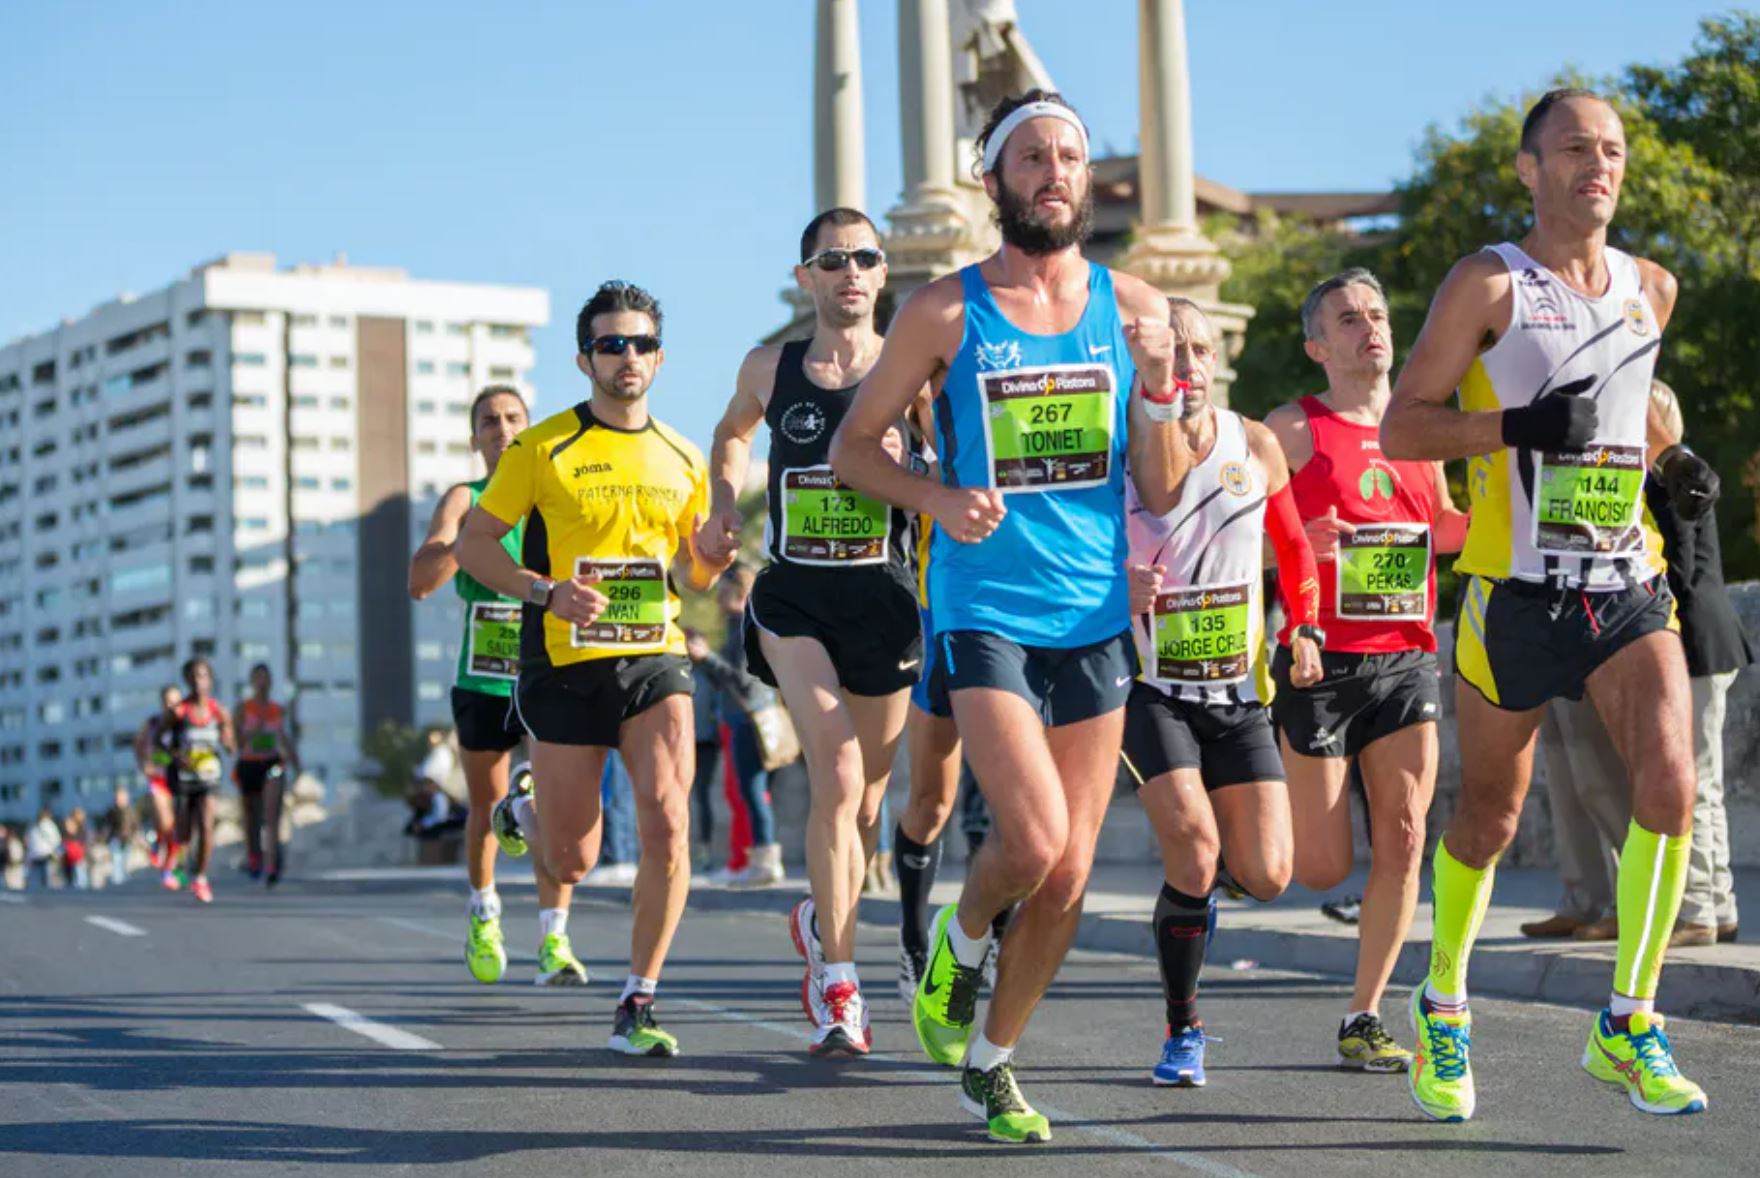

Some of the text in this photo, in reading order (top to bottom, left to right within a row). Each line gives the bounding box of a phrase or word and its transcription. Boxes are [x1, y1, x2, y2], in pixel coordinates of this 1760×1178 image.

[1030, 403, 1073, 424] 267
[1020, 427, 1084, 453] TONIET
[1582, 475, 1618, 494] 144
[819, 495, 856, 513] 173
[802, 515, 873, 535] ALFREDO
[1372, 552, 1406, 569] 270
[1366, 572, 1412, 590] PEKAS
[608, 585, 641, 601] 296
[608, 602, 639, 620] IVAN
[1191, 615, 1225, 633] 135
[499, 626, 521, 641] 25
[1160, 630, 1247, 657] JORGE CRZ
